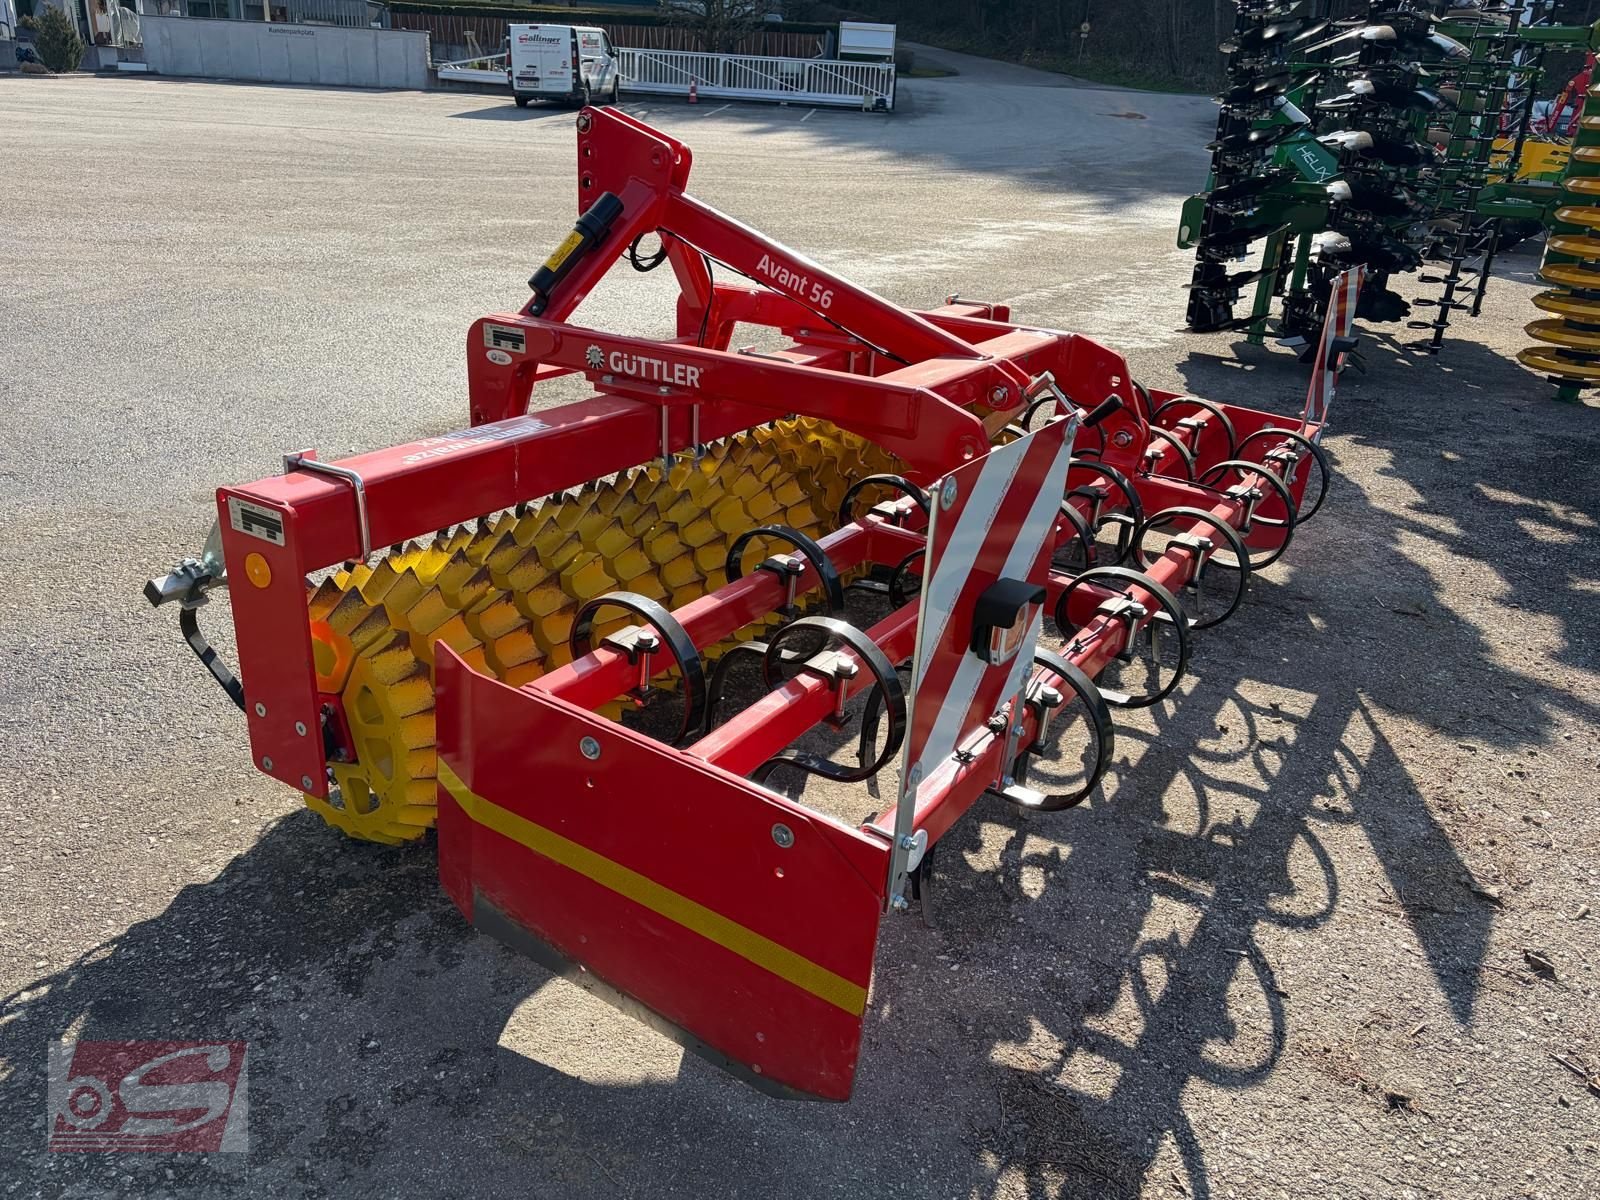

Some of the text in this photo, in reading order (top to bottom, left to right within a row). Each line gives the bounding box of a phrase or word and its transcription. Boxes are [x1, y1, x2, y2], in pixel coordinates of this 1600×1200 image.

[268, 26, 314, 36] Kundenparkplatz
[1296, 145, 1331, 181] HELIX
[756, 254, 834, 309] Avant 56
